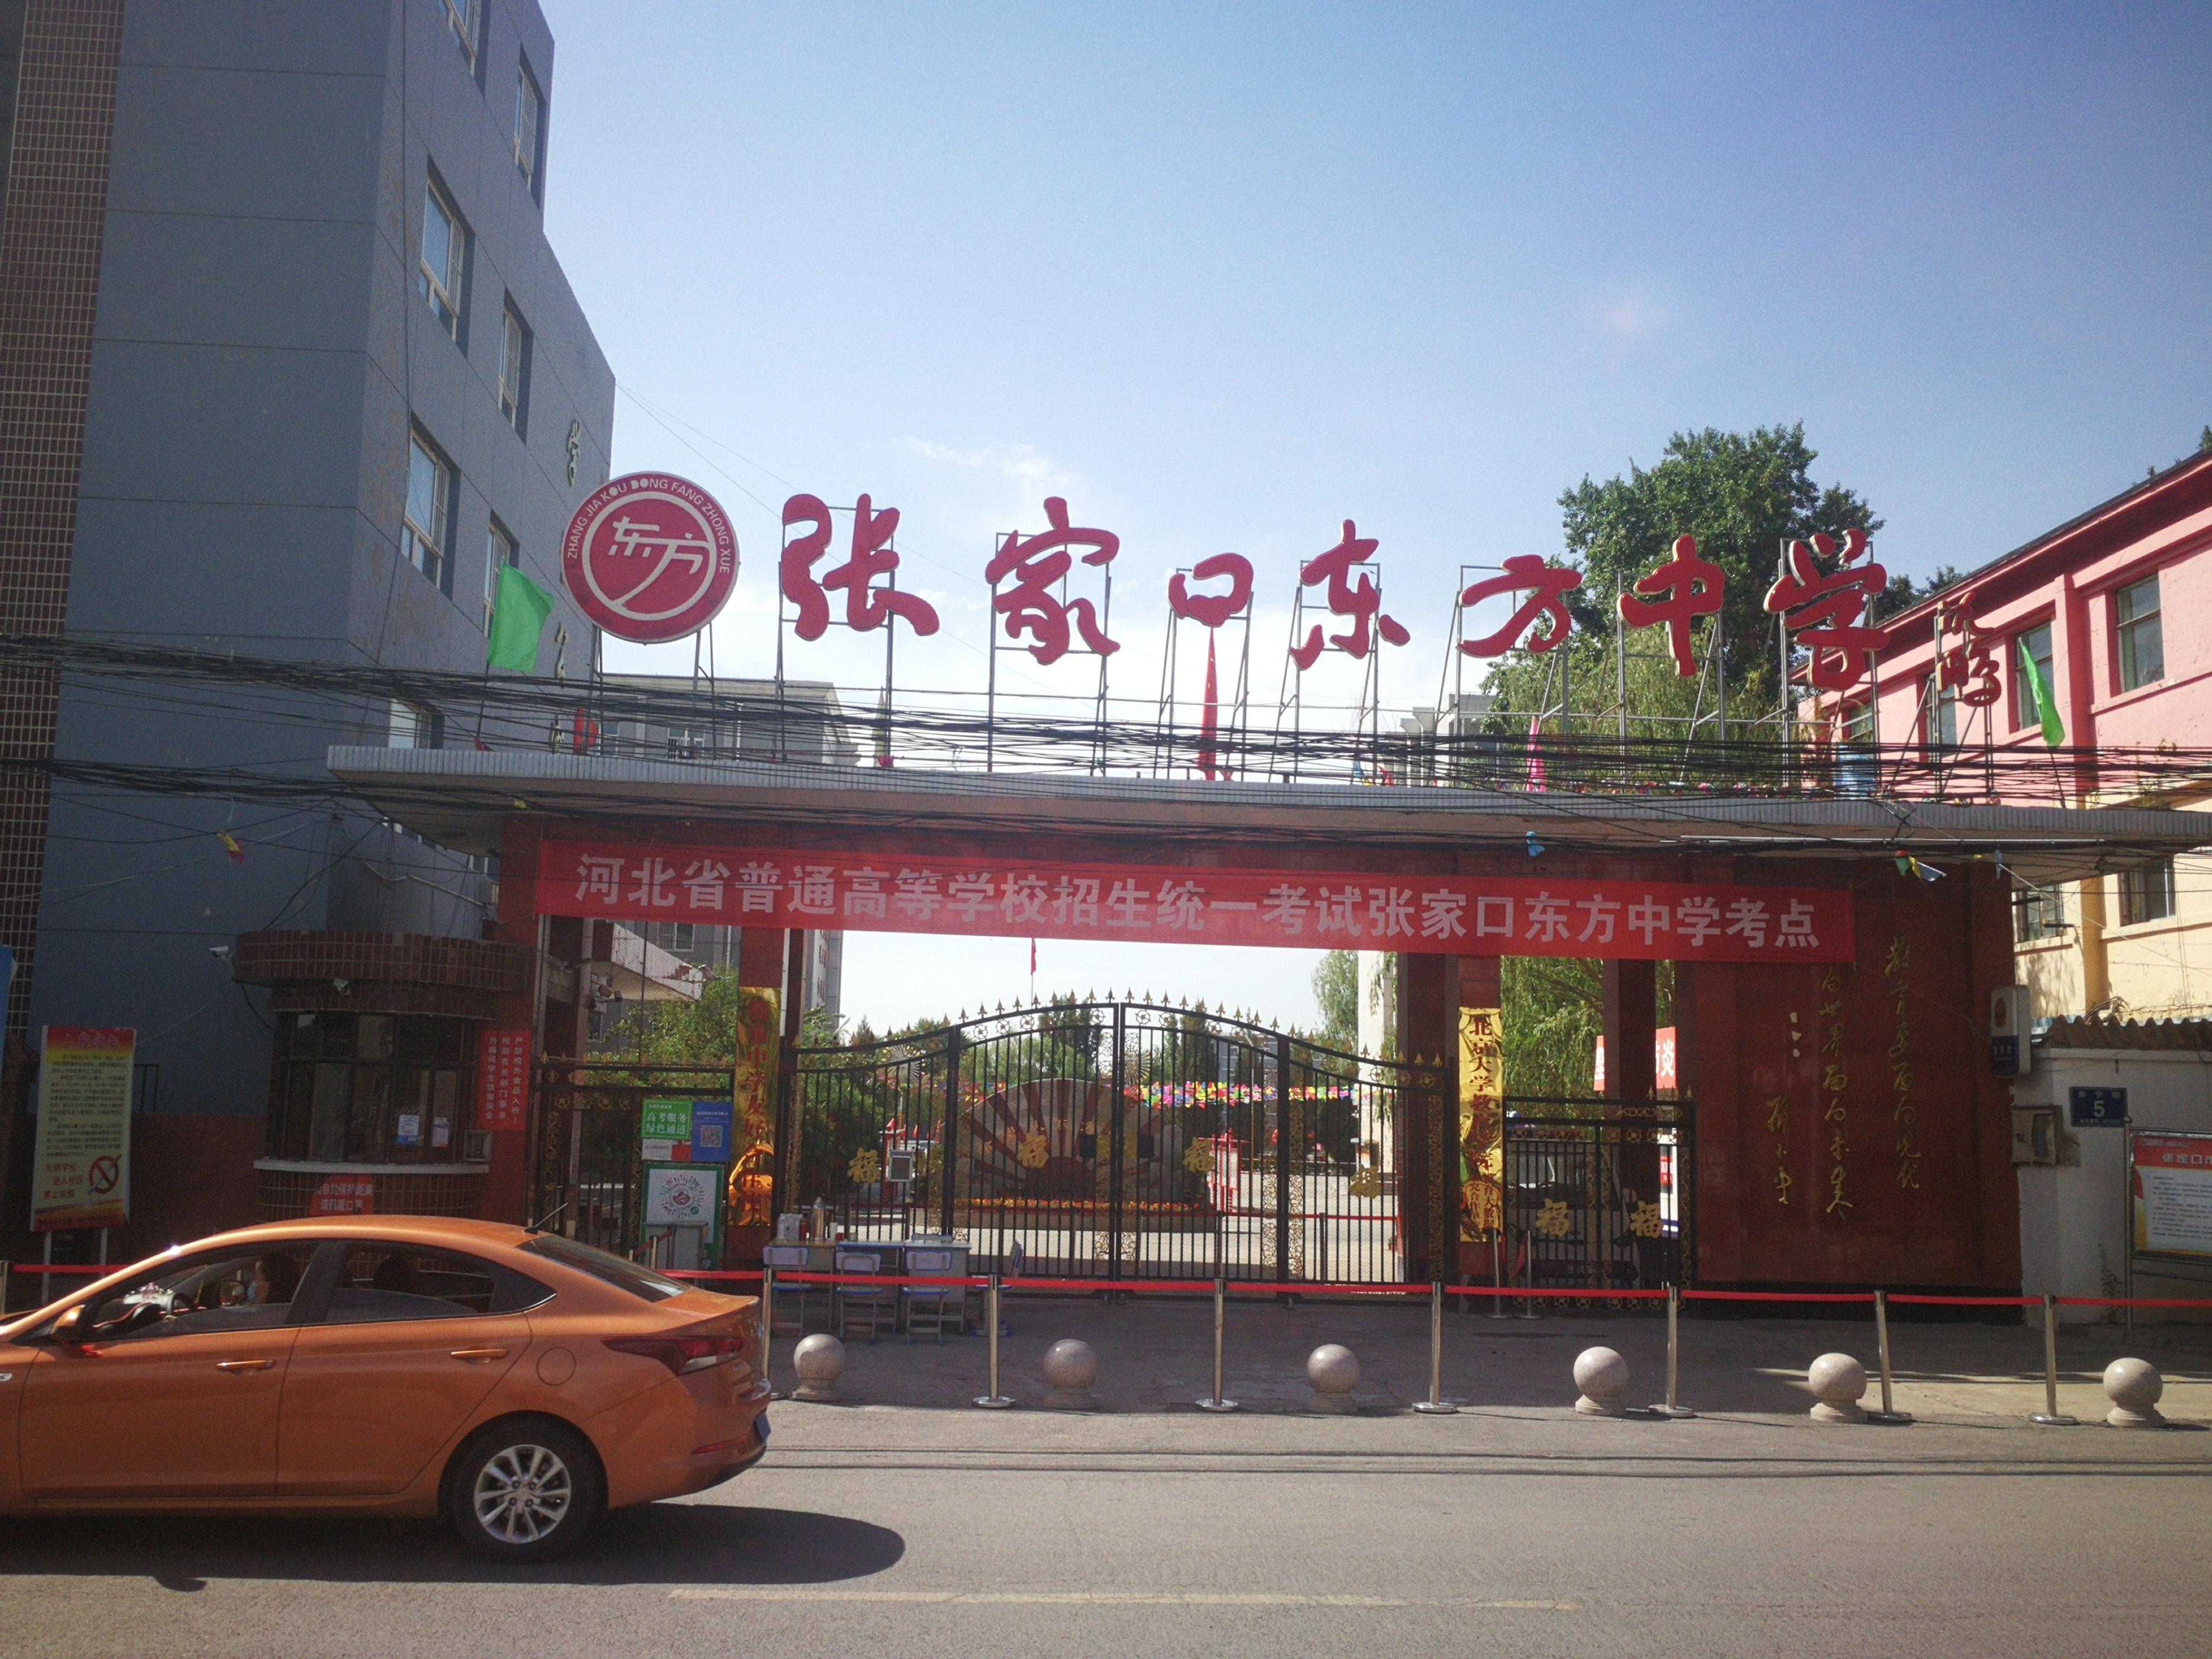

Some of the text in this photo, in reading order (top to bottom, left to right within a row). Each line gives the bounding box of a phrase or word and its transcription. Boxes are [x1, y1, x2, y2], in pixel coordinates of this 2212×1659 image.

[567, 477, 731, 574] ZHANG JIA KOU DONG FANG ZHONG XUE
[781, 493, 1891, 692] 张家口东方中学
[576, 853, 1820, 948] 河北省普通高等学校招生统一考试张家口东方中学考点
[2094, 1100, 2106, 1117] 5
[1536, 1198, 1570, 1237] 福
[1630, 1200, 1664, 1238] 福
